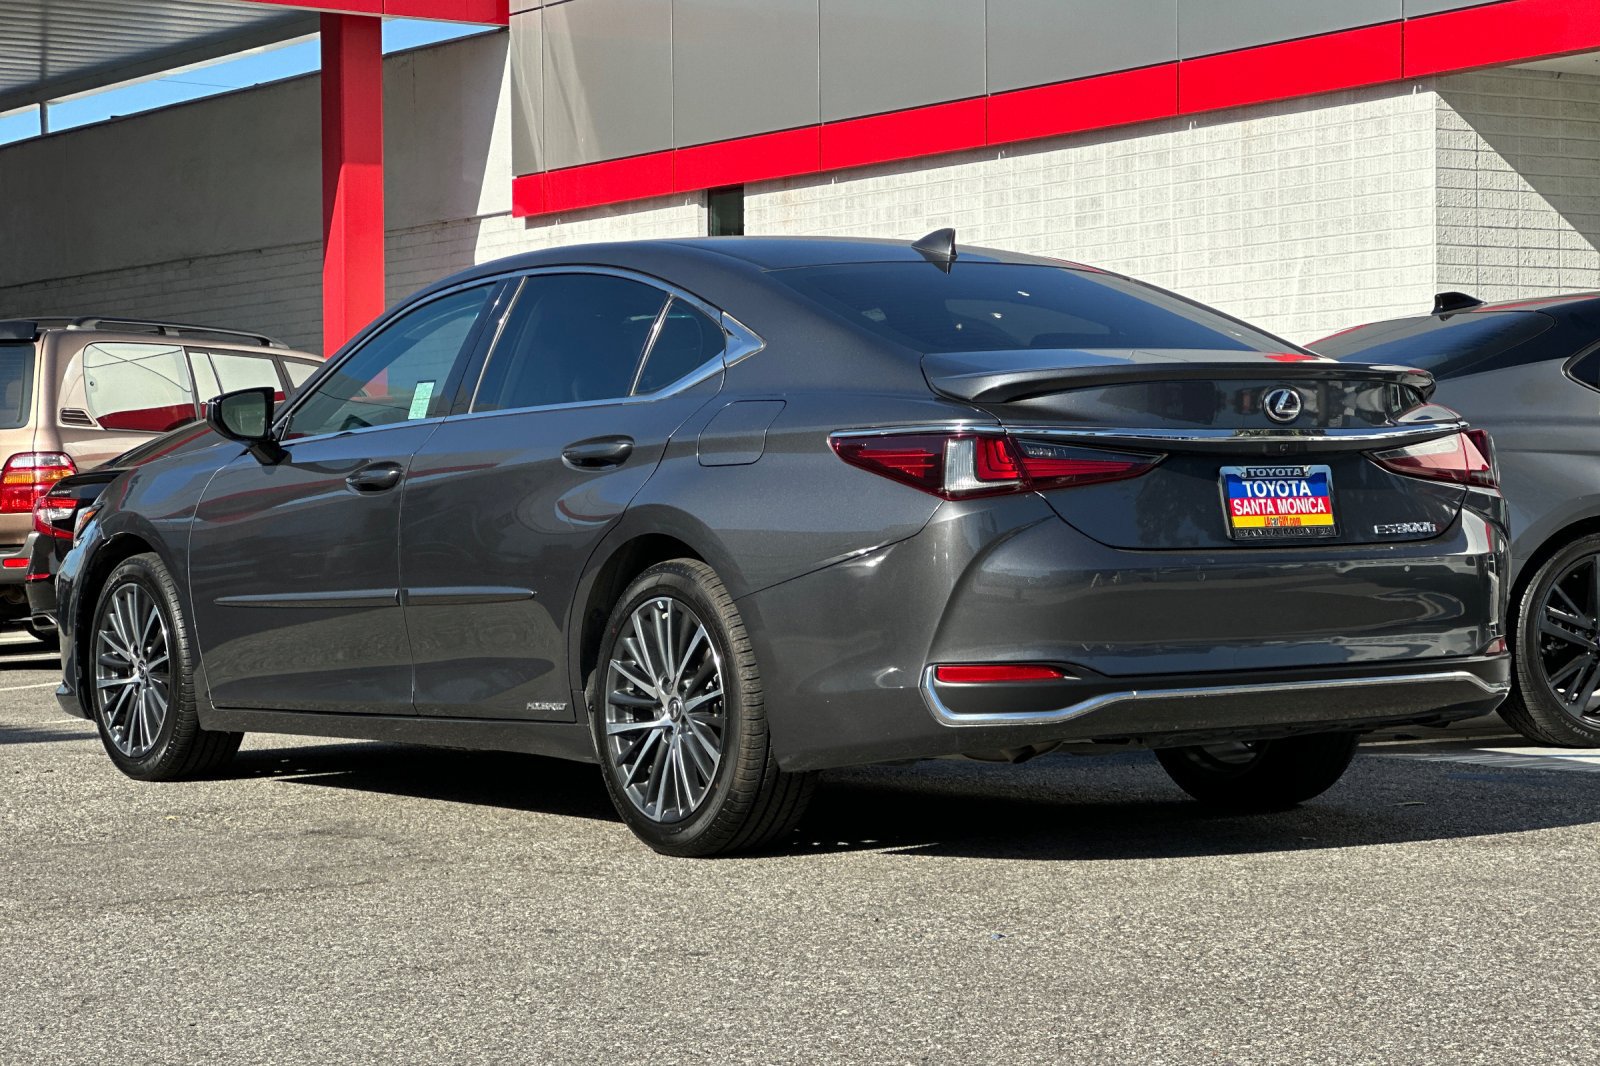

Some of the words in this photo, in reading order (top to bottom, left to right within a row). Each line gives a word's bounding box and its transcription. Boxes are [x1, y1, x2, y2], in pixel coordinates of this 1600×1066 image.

[1247, 468, 1303, 477] TOYOTA
[1242, 480, 1312, 498] TOYOTA
[1233, 498, 1276, 515] SANTA
[1277, 497, 1326, 514] MONICA
